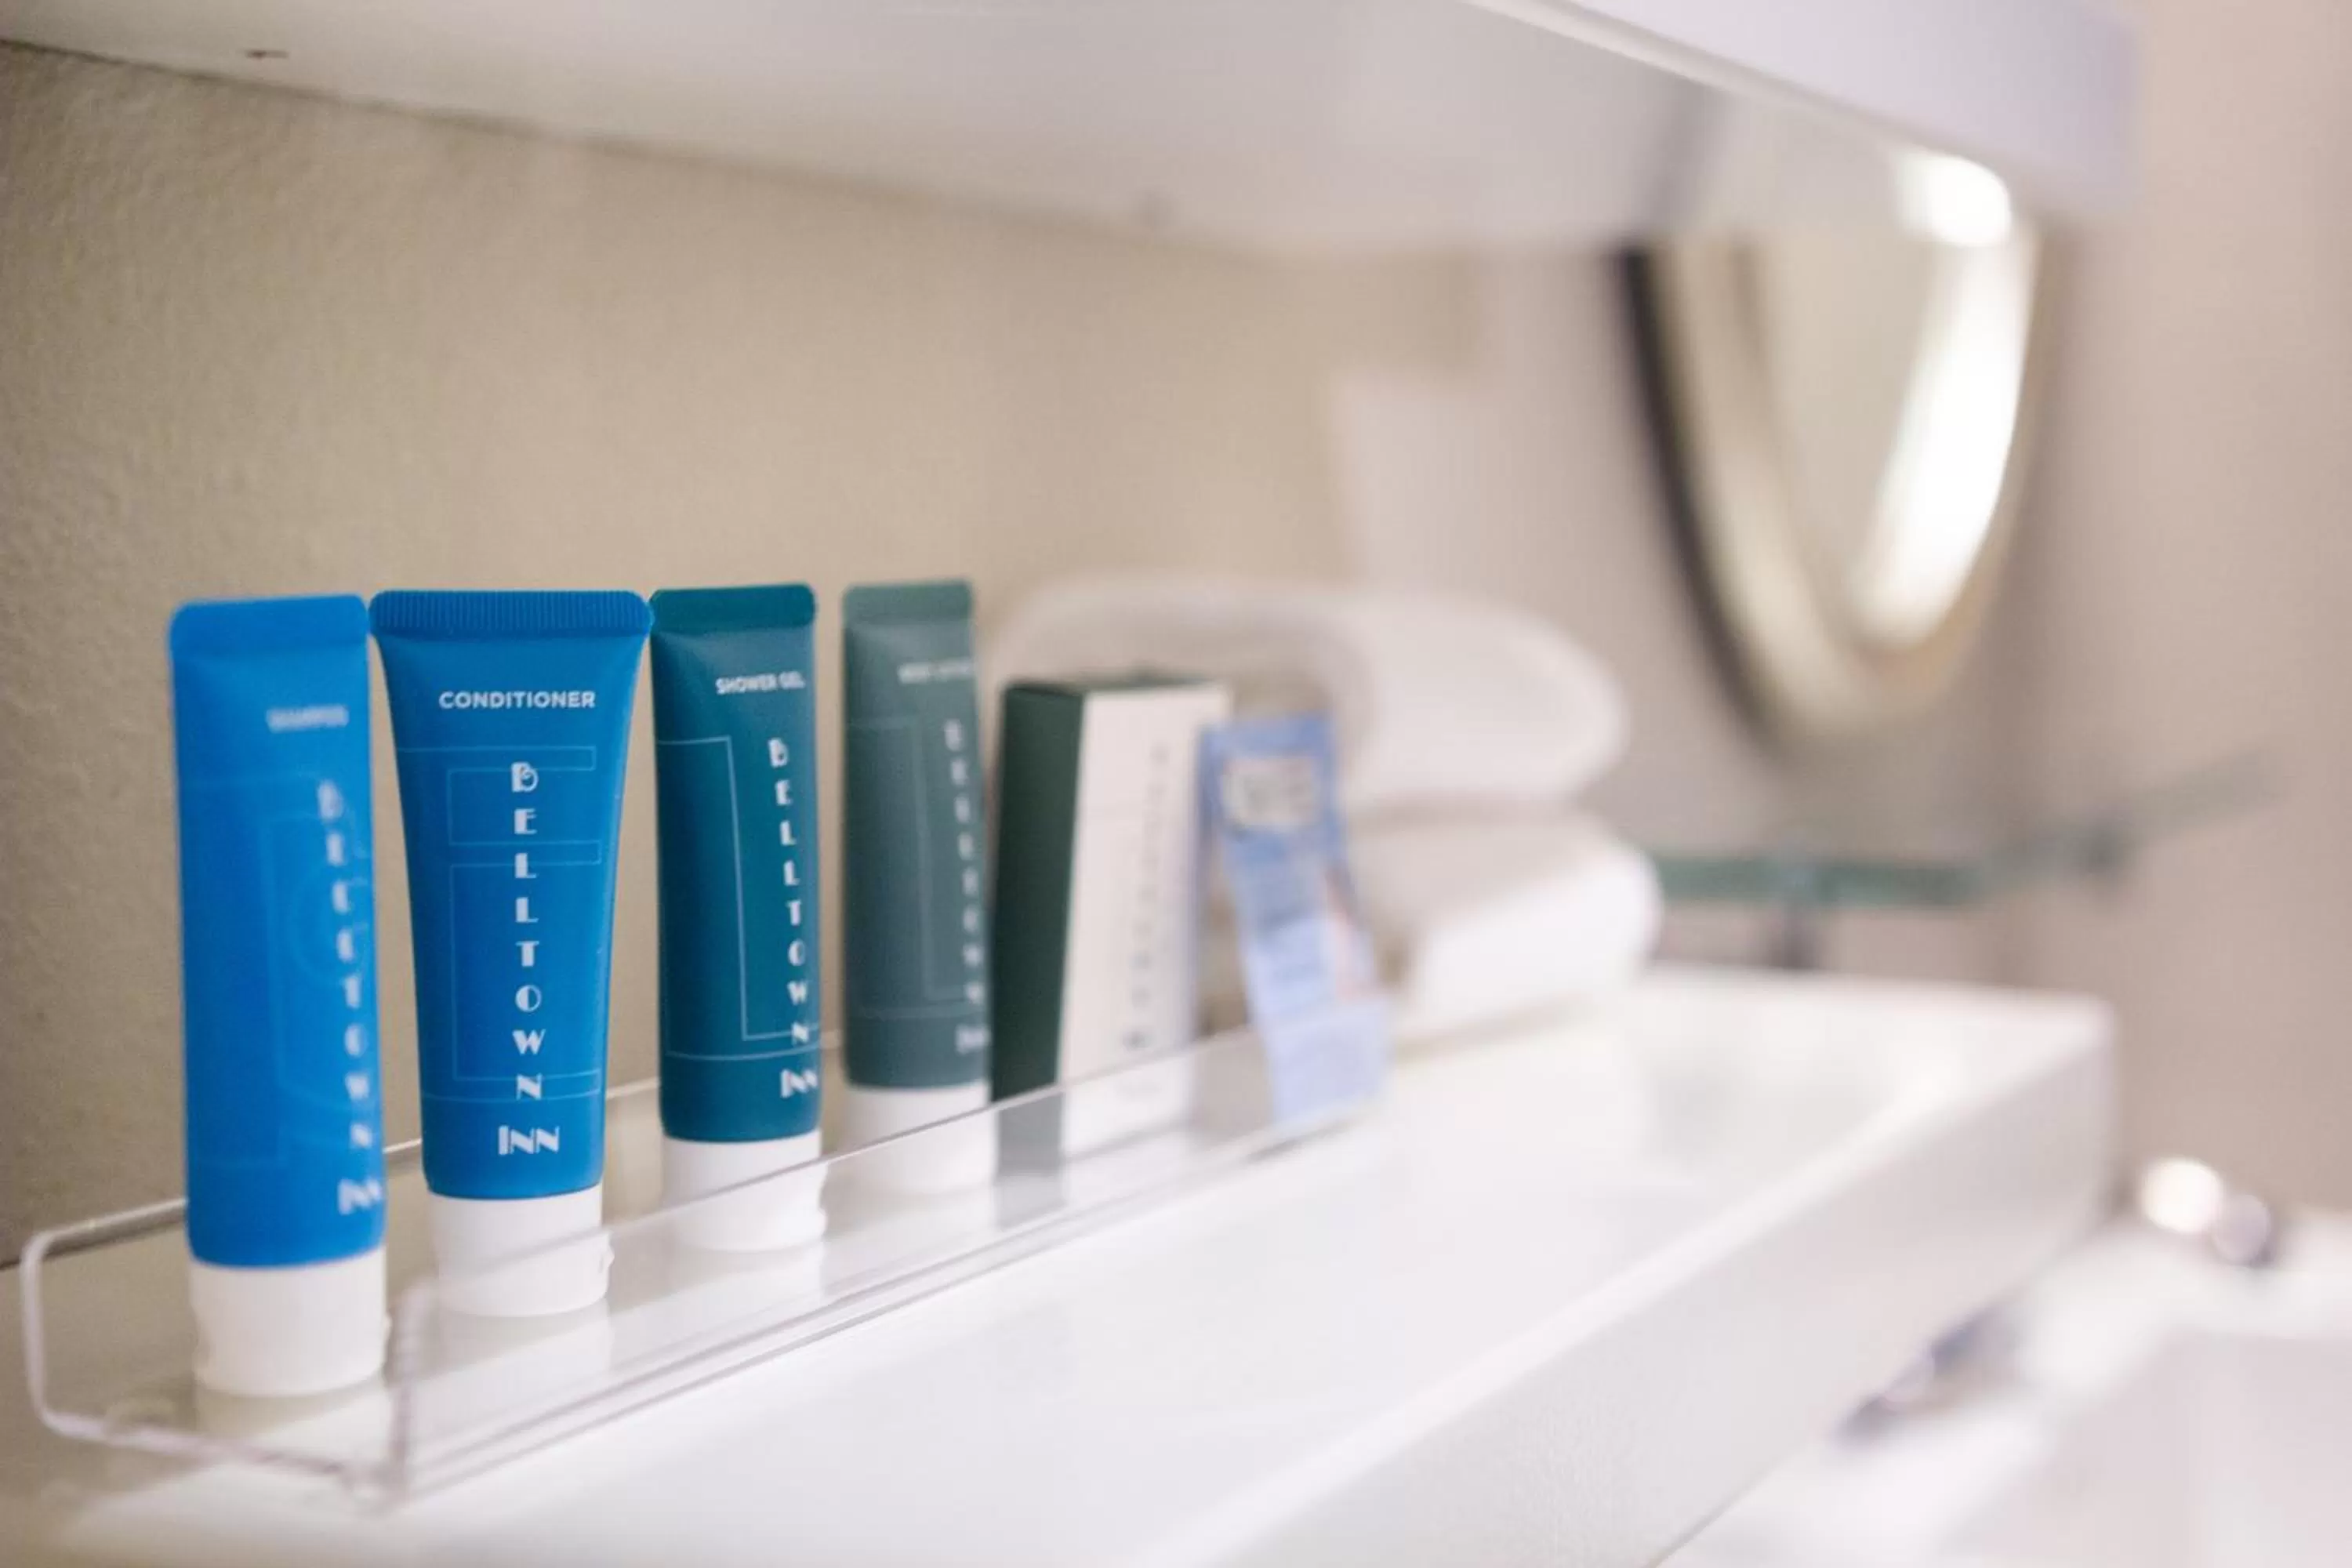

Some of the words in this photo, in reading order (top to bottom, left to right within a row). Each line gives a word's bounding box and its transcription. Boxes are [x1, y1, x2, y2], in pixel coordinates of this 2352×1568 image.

[438, 691, 597, 710] CONDITIONER
[715, 677, 776, 695] SHOWER
[768, 737, 810, 1045] BELLTOWN
[510, 760, 547, 1101] BELLTOWN
[498, 1124, 561, 1156] INN
